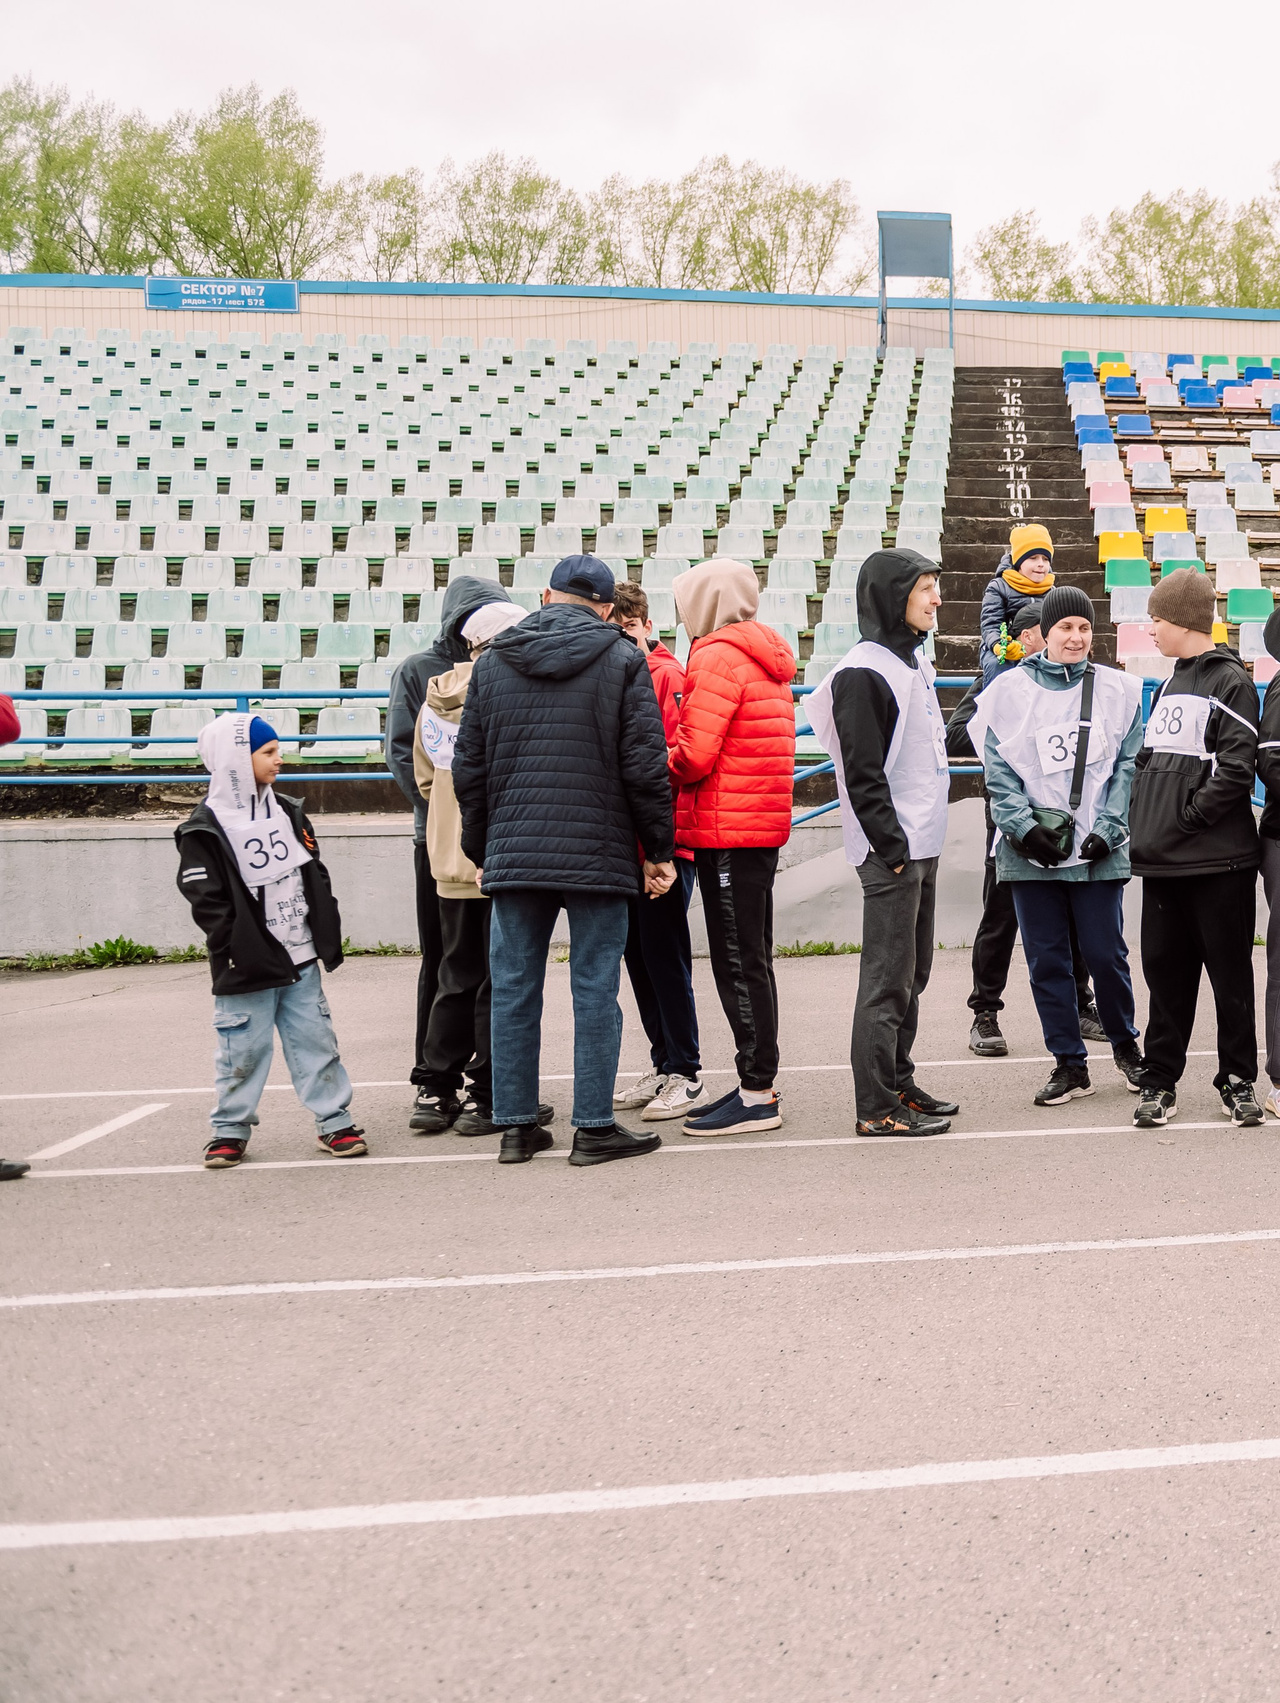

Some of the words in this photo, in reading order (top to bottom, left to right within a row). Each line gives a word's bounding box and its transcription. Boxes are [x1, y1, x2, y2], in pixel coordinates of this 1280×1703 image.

[181, 284, 236, 295] СЕКТОР
[241, 285, 265, 297] №7
[247, 299, 265, 307] 572
[1003, 378, 1022, 388] 17
[1003, 393, 1023, 406] 16
[1003, 448, 1025, 462] 12
[1006, 466, 1027, 480] 11
[1006, 483, 1031, 499] 10
[1010, 503, 1024, 519] 9
[1155, 705, 1183, 735] 38
[244, 830, 289, 870] 35
